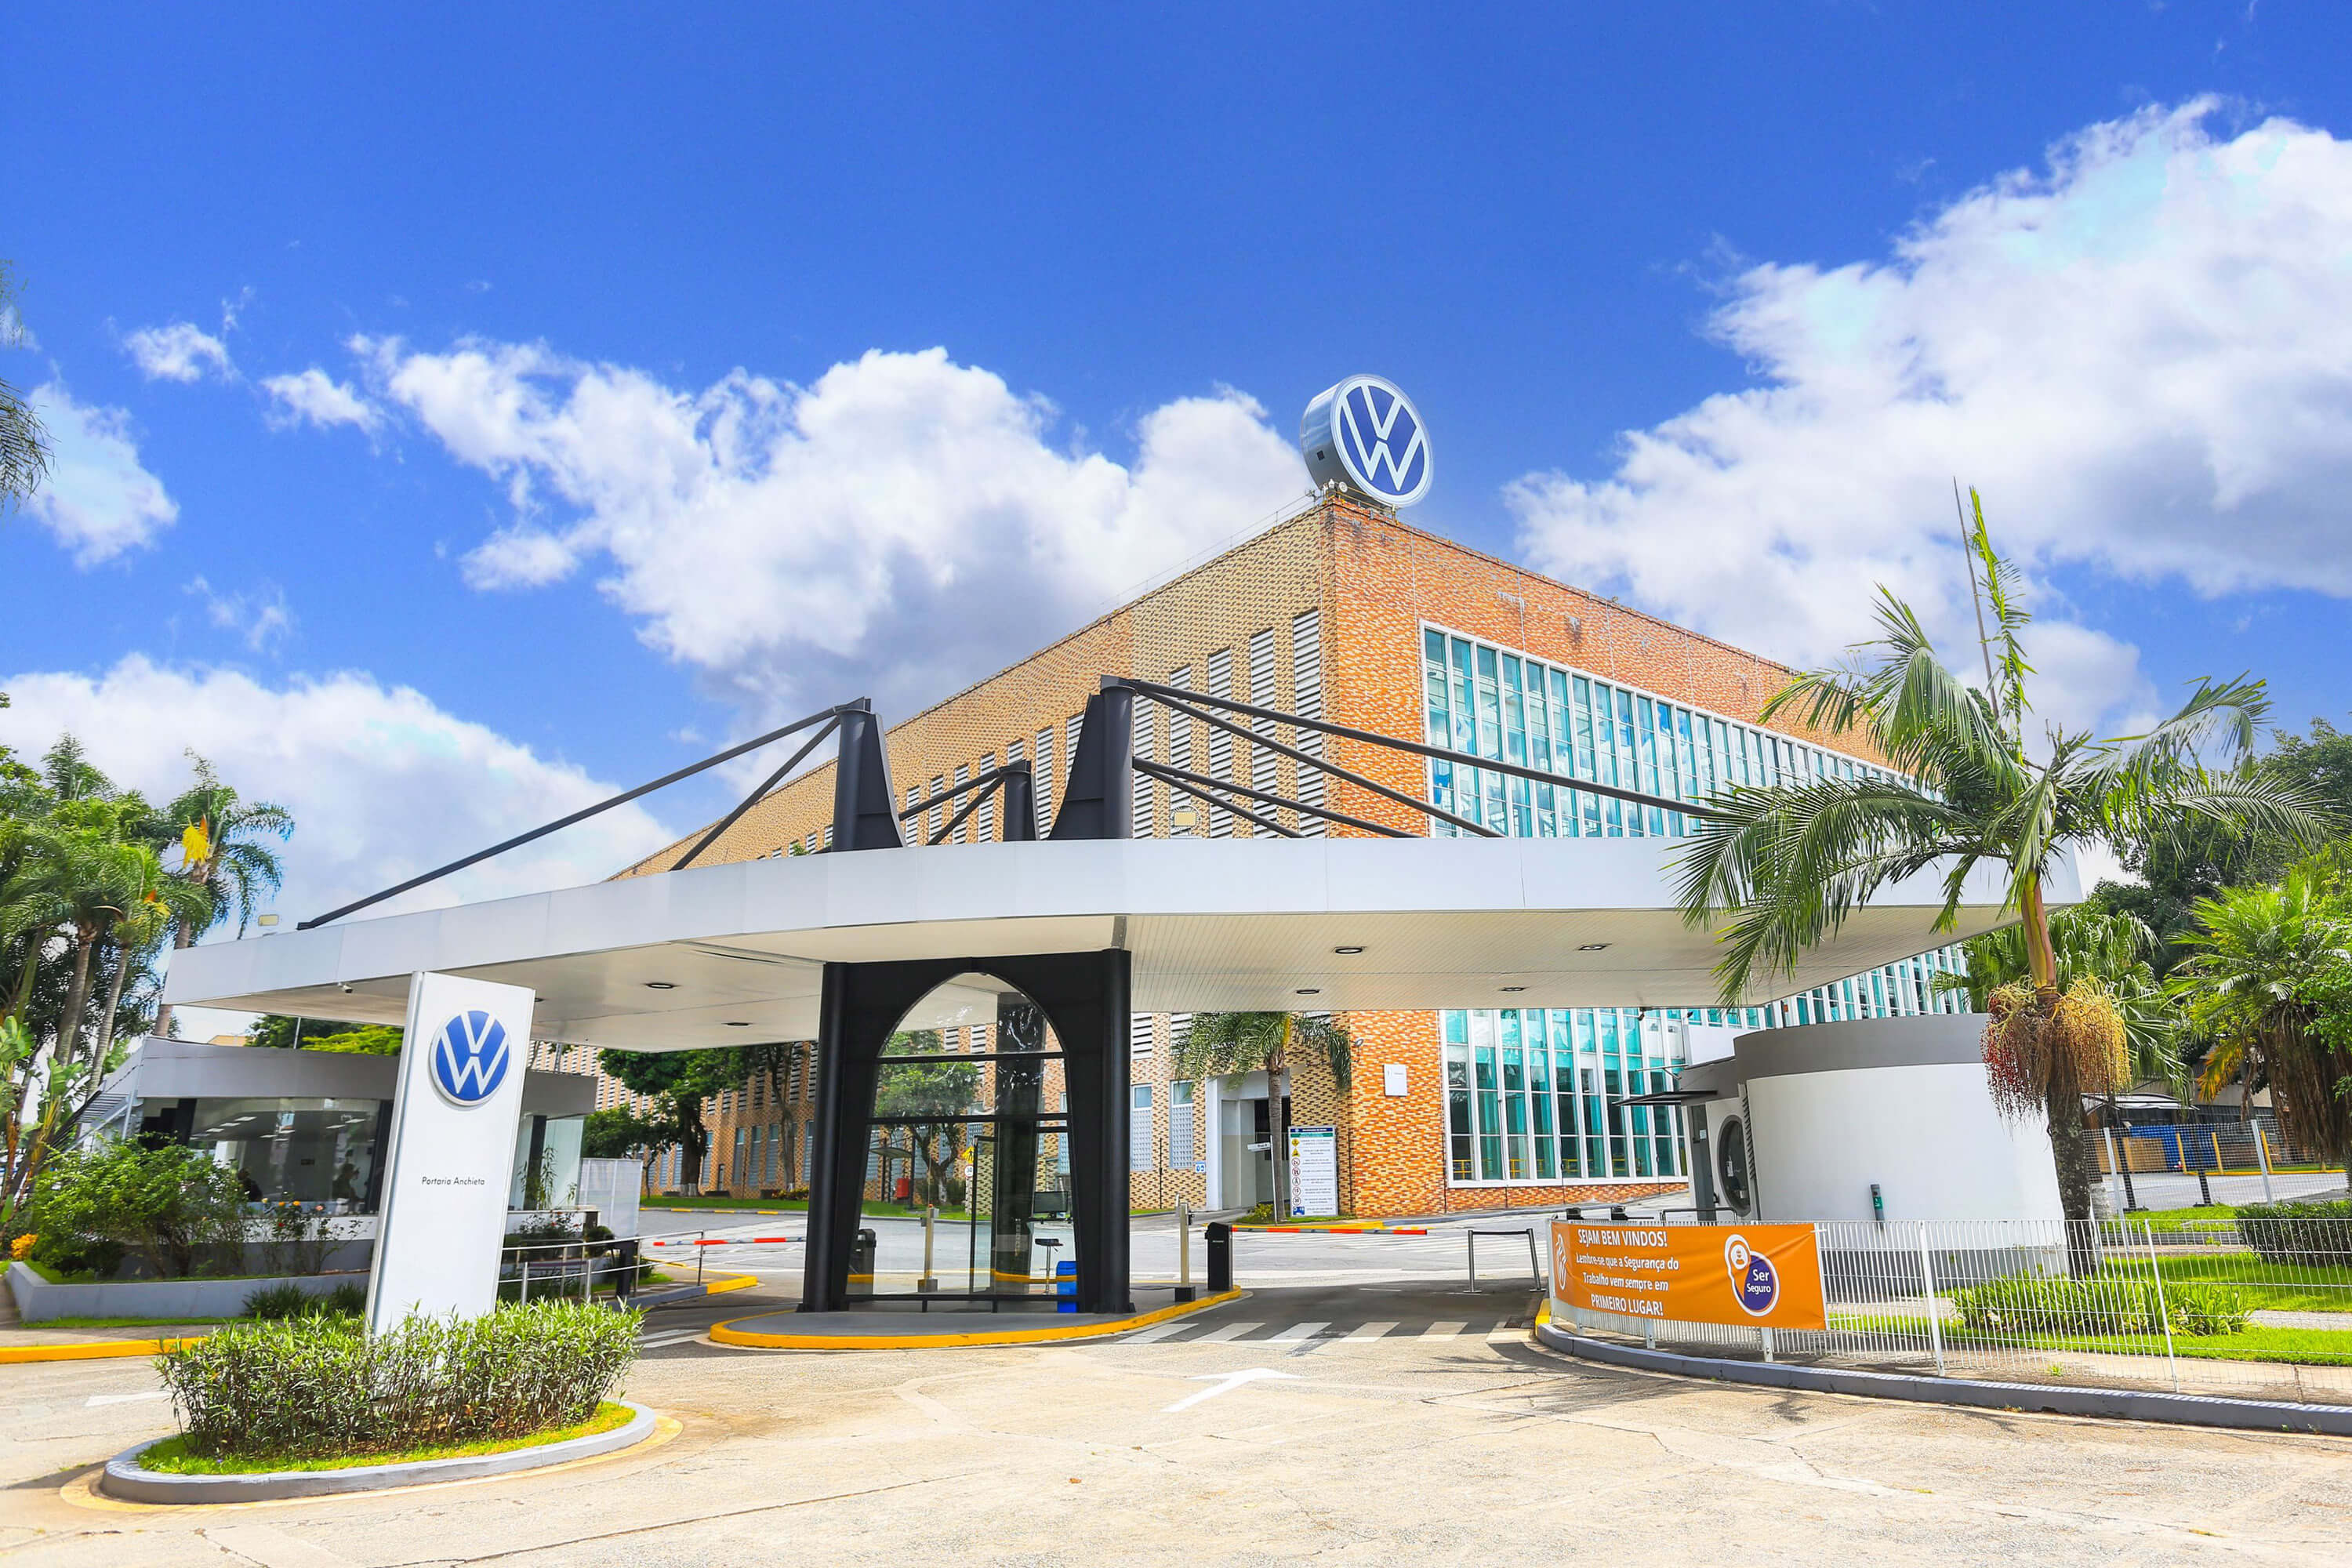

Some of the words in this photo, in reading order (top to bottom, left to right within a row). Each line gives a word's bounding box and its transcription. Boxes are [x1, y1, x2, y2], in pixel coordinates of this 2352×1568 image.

[1338, 380, 1425, 493] VW
[437, 1010, 510, 1097] VW
[422, 1176, 452, 1185] Portaria
[454, 1177, 485, 1185] Anchieta
[1577, 1229, 1600, 1247] SEJAM
[1601, 1230, 1621, 1246] BEM
[1621, 1231, 1668, 1247] VINDOS!
[1576, 1252, 1605, 1265] Lembre-se
[1606, 1258, 1617, 1269] que
[1618, 1258, 1623, 1267] a
[1624, 1256, 1665, 1272] Segurança
[1667, 1257, 1679, 1270] do
[1583, 1272, 1609, 1286] Trabalho
[1624, 1280, 1653, 1292] sempre
[1654, 1283, 1668, 1291] em
[1752, 1269, 1769, 1281] Ser
[1746, 1283, 1772, 1294] Seguro
[1591, 1294, 1627, 1312] PRIMEIRO
[1628, 1299, 1664, 1316] LUGAR!
